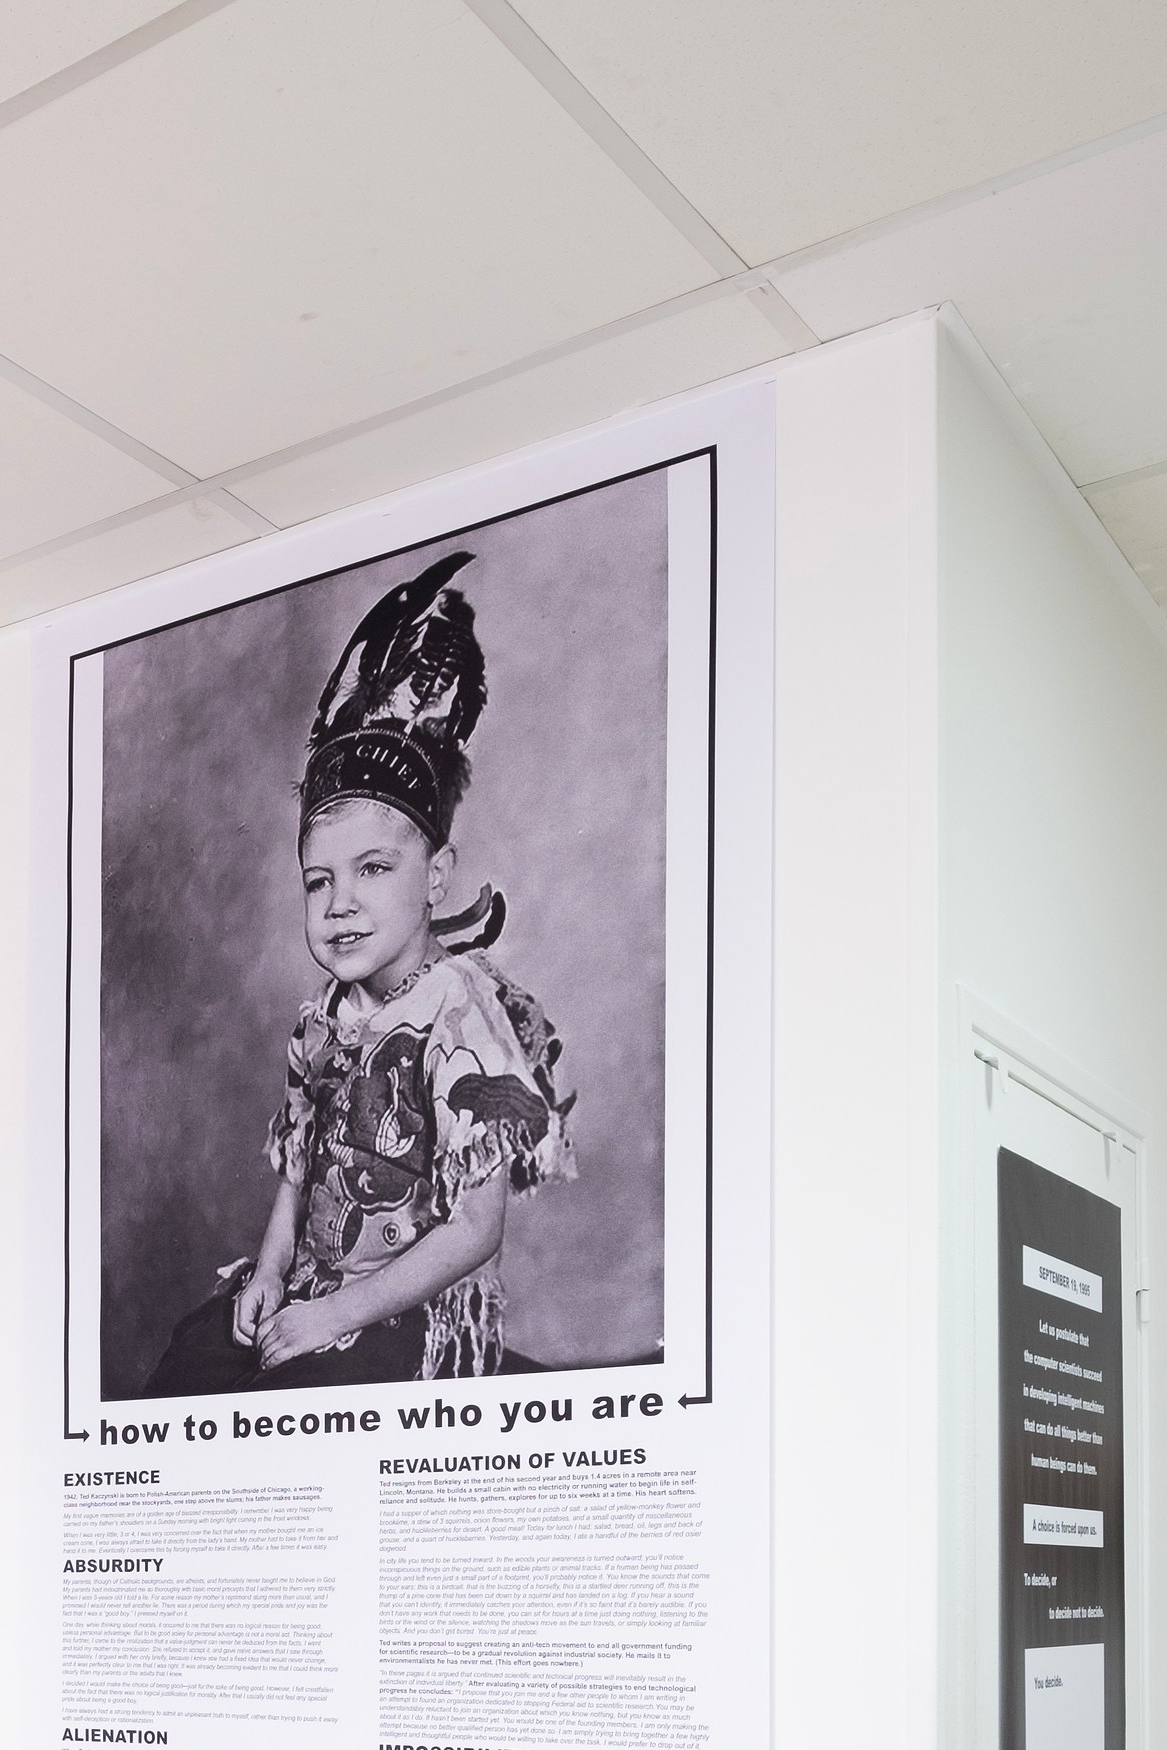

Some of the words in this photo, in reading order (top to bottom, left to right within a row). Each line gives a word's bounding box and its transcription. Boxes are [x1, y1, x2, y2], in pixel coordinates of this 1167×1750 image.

[1039, 1266, 1069, 1288] SEPTEMBER
[100, 1419, 170, 1445] how
[184, 1414, 218, 1441] to
[233, 1409, 381, 1438] become
[398, 1399, 483, 1429] who
[499, 1399, 573, 1433] you
[592, 1392, 663, 1419] are
[380, 1454, 520, 1474] REVALUATION
[529, 1453, 555, 1469] OF
[563, 1448, 646, 1467] VALUES
[64, 1470, 161, 1487] EXISTENCE
[1033, 1519, 1037, 1531] A
[1038, 1520, 1054, 1533] choice
[1056, 1522, 1060, 1533] is
[1061, 1522, 1076, 1534] forced
[1078, 1525, 1089, 1537] upon
[63, 1559, 163, 1573] ABSURDITY
[1034, 1678, 1044, 1689] You
[1045, 1676, 1063, 1689] decide.
[62, 1727, 168, 1745] ALIENATION
